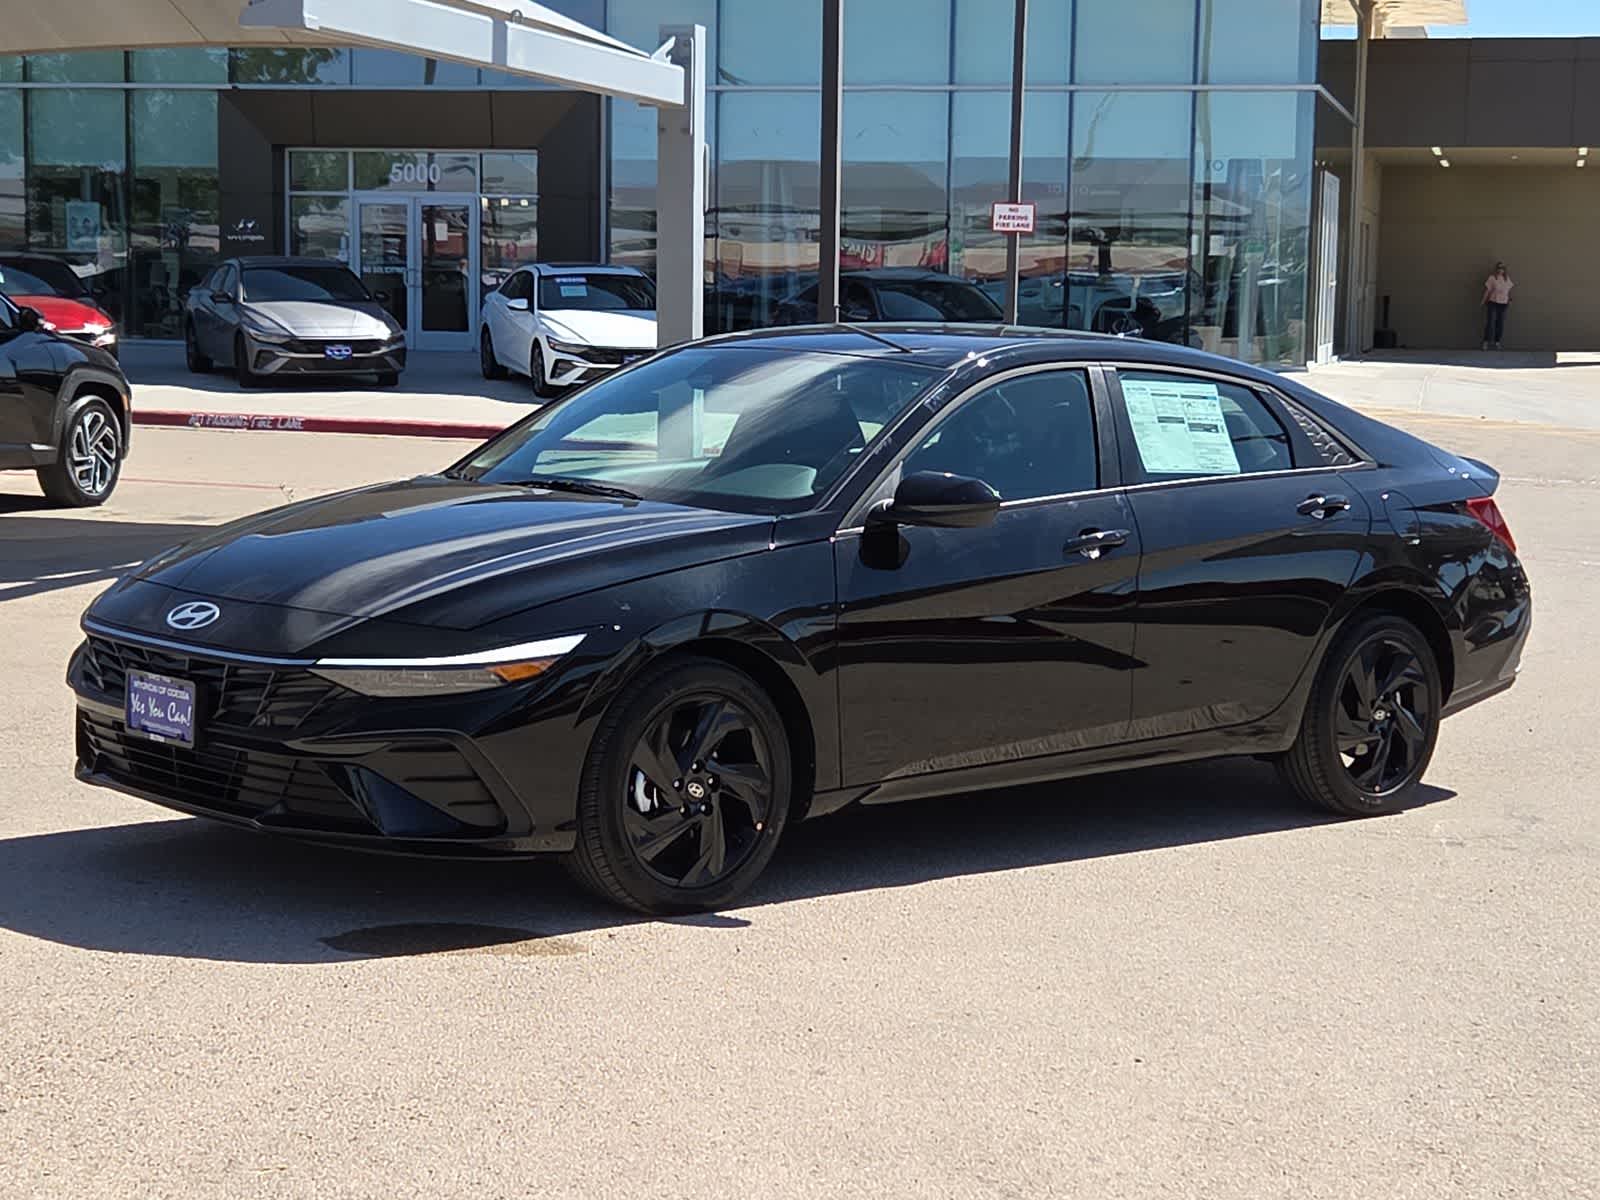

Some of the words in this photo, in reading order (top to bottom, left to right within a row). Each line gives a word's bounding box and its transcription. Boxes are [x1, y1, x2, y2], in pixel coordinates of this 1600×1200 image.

[390, 162, 441, 184] 5000
[277, 416, 304, 429] LANE
[130, 692, 146, 715] Yes
[148, 695, 165, 718] You
[167, 701, 193, 727] Can!
